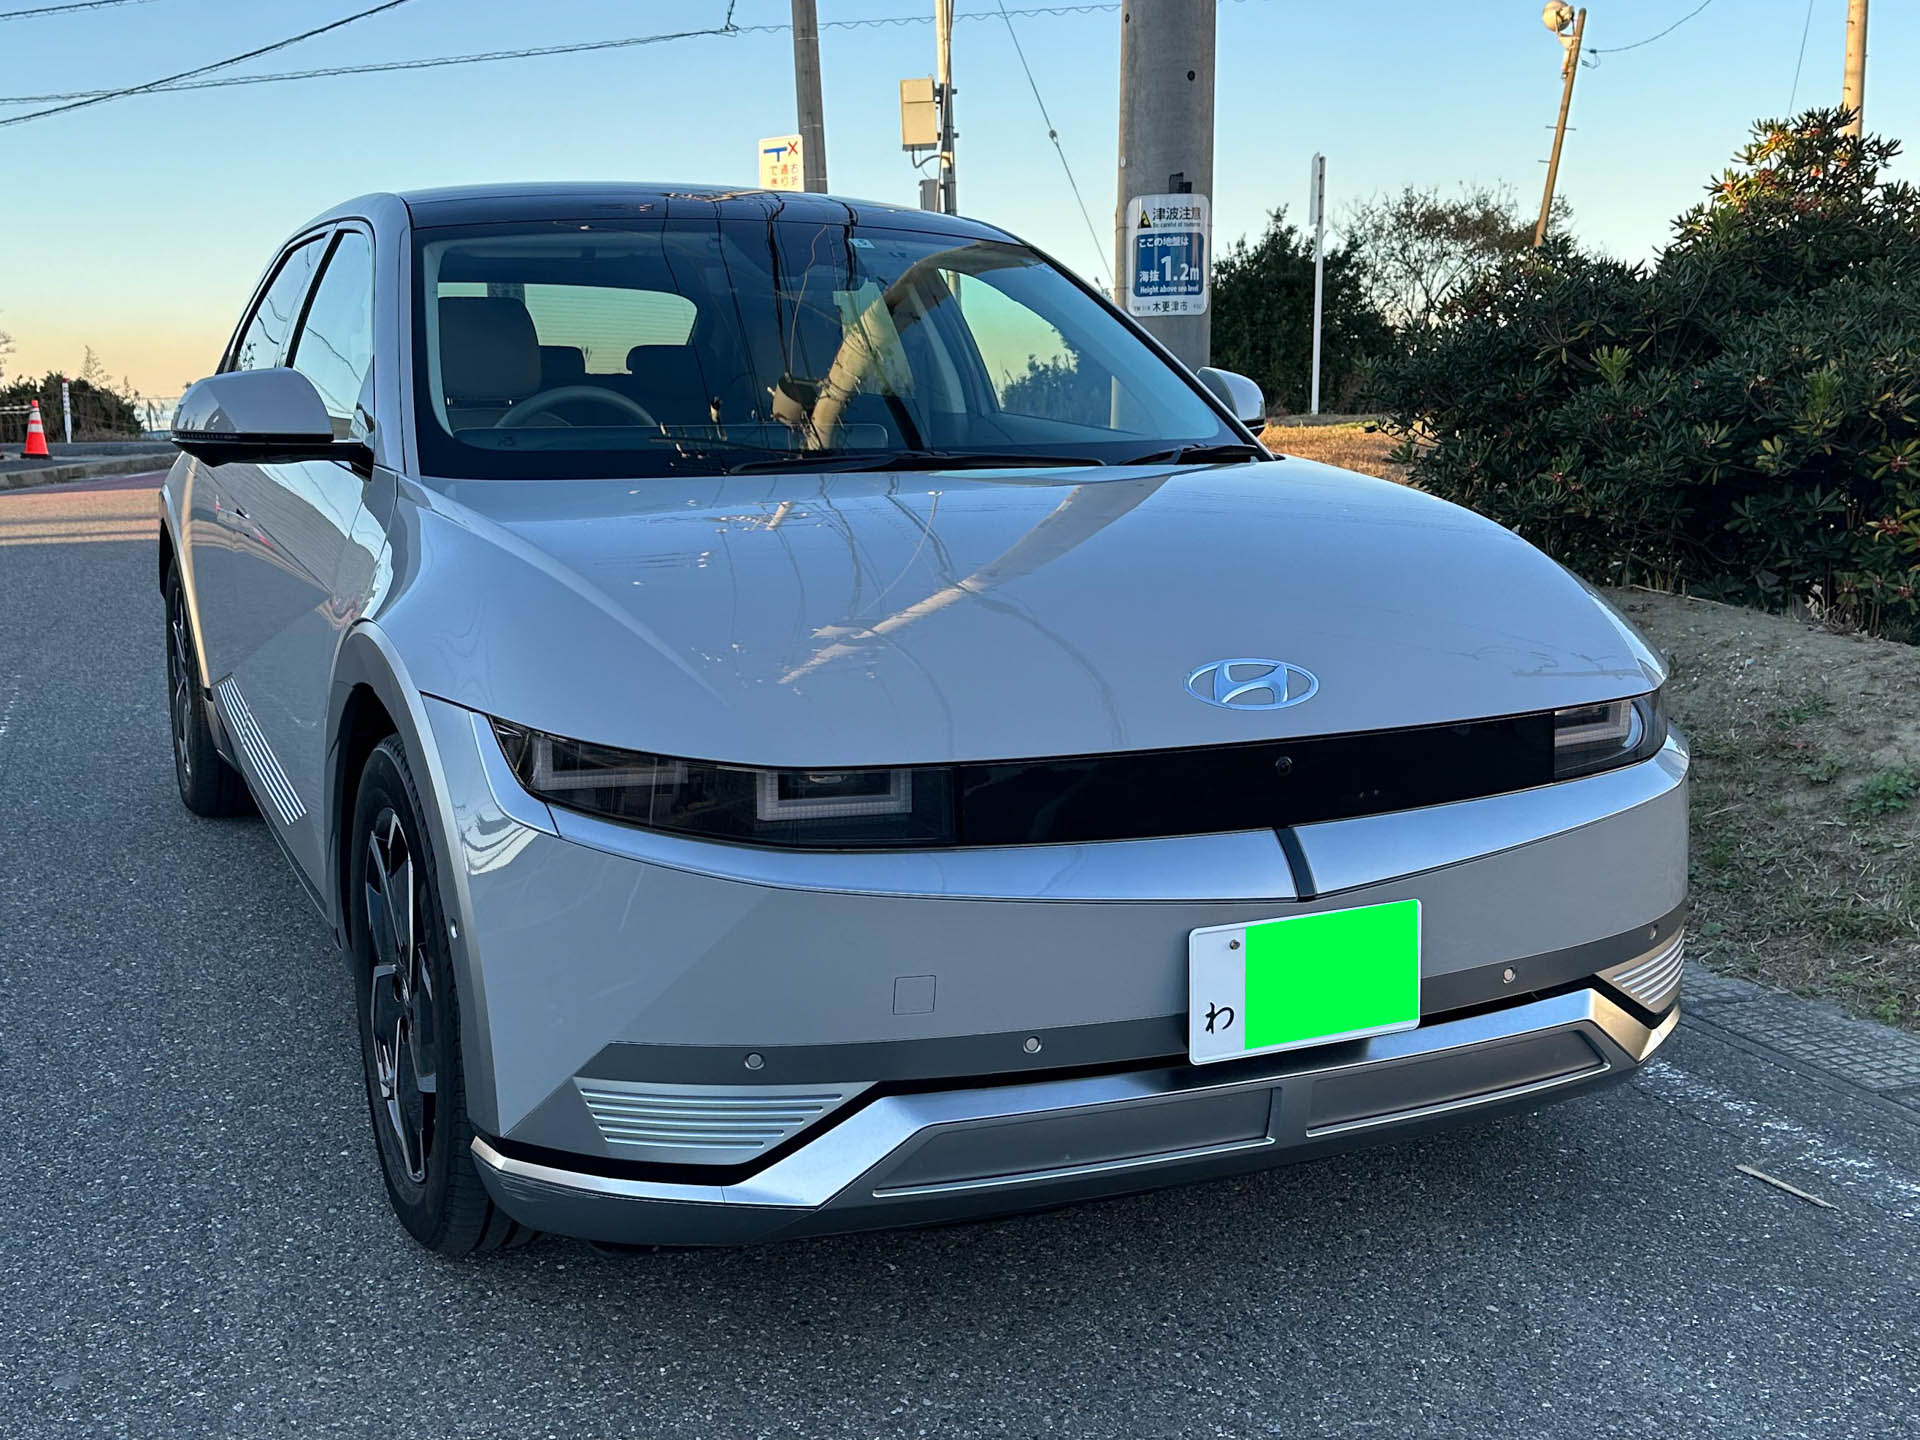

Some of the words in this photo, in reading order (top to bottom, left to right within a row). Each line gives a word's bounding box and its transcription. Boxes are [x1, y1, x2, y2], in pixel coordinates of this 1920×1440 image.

[1153, 207, 1201, 221] 津波注意
[1139, 237, 1189, 248] ここの地盤は
[1139, 270, 1160, 283] 海抜
[1140, 286, 1159, 295] Height
[1160, 285, 1177, 293] above
[1152, 301, 1188, 313] 木更津市
[1205, 1001, 1235, 1035] わ
